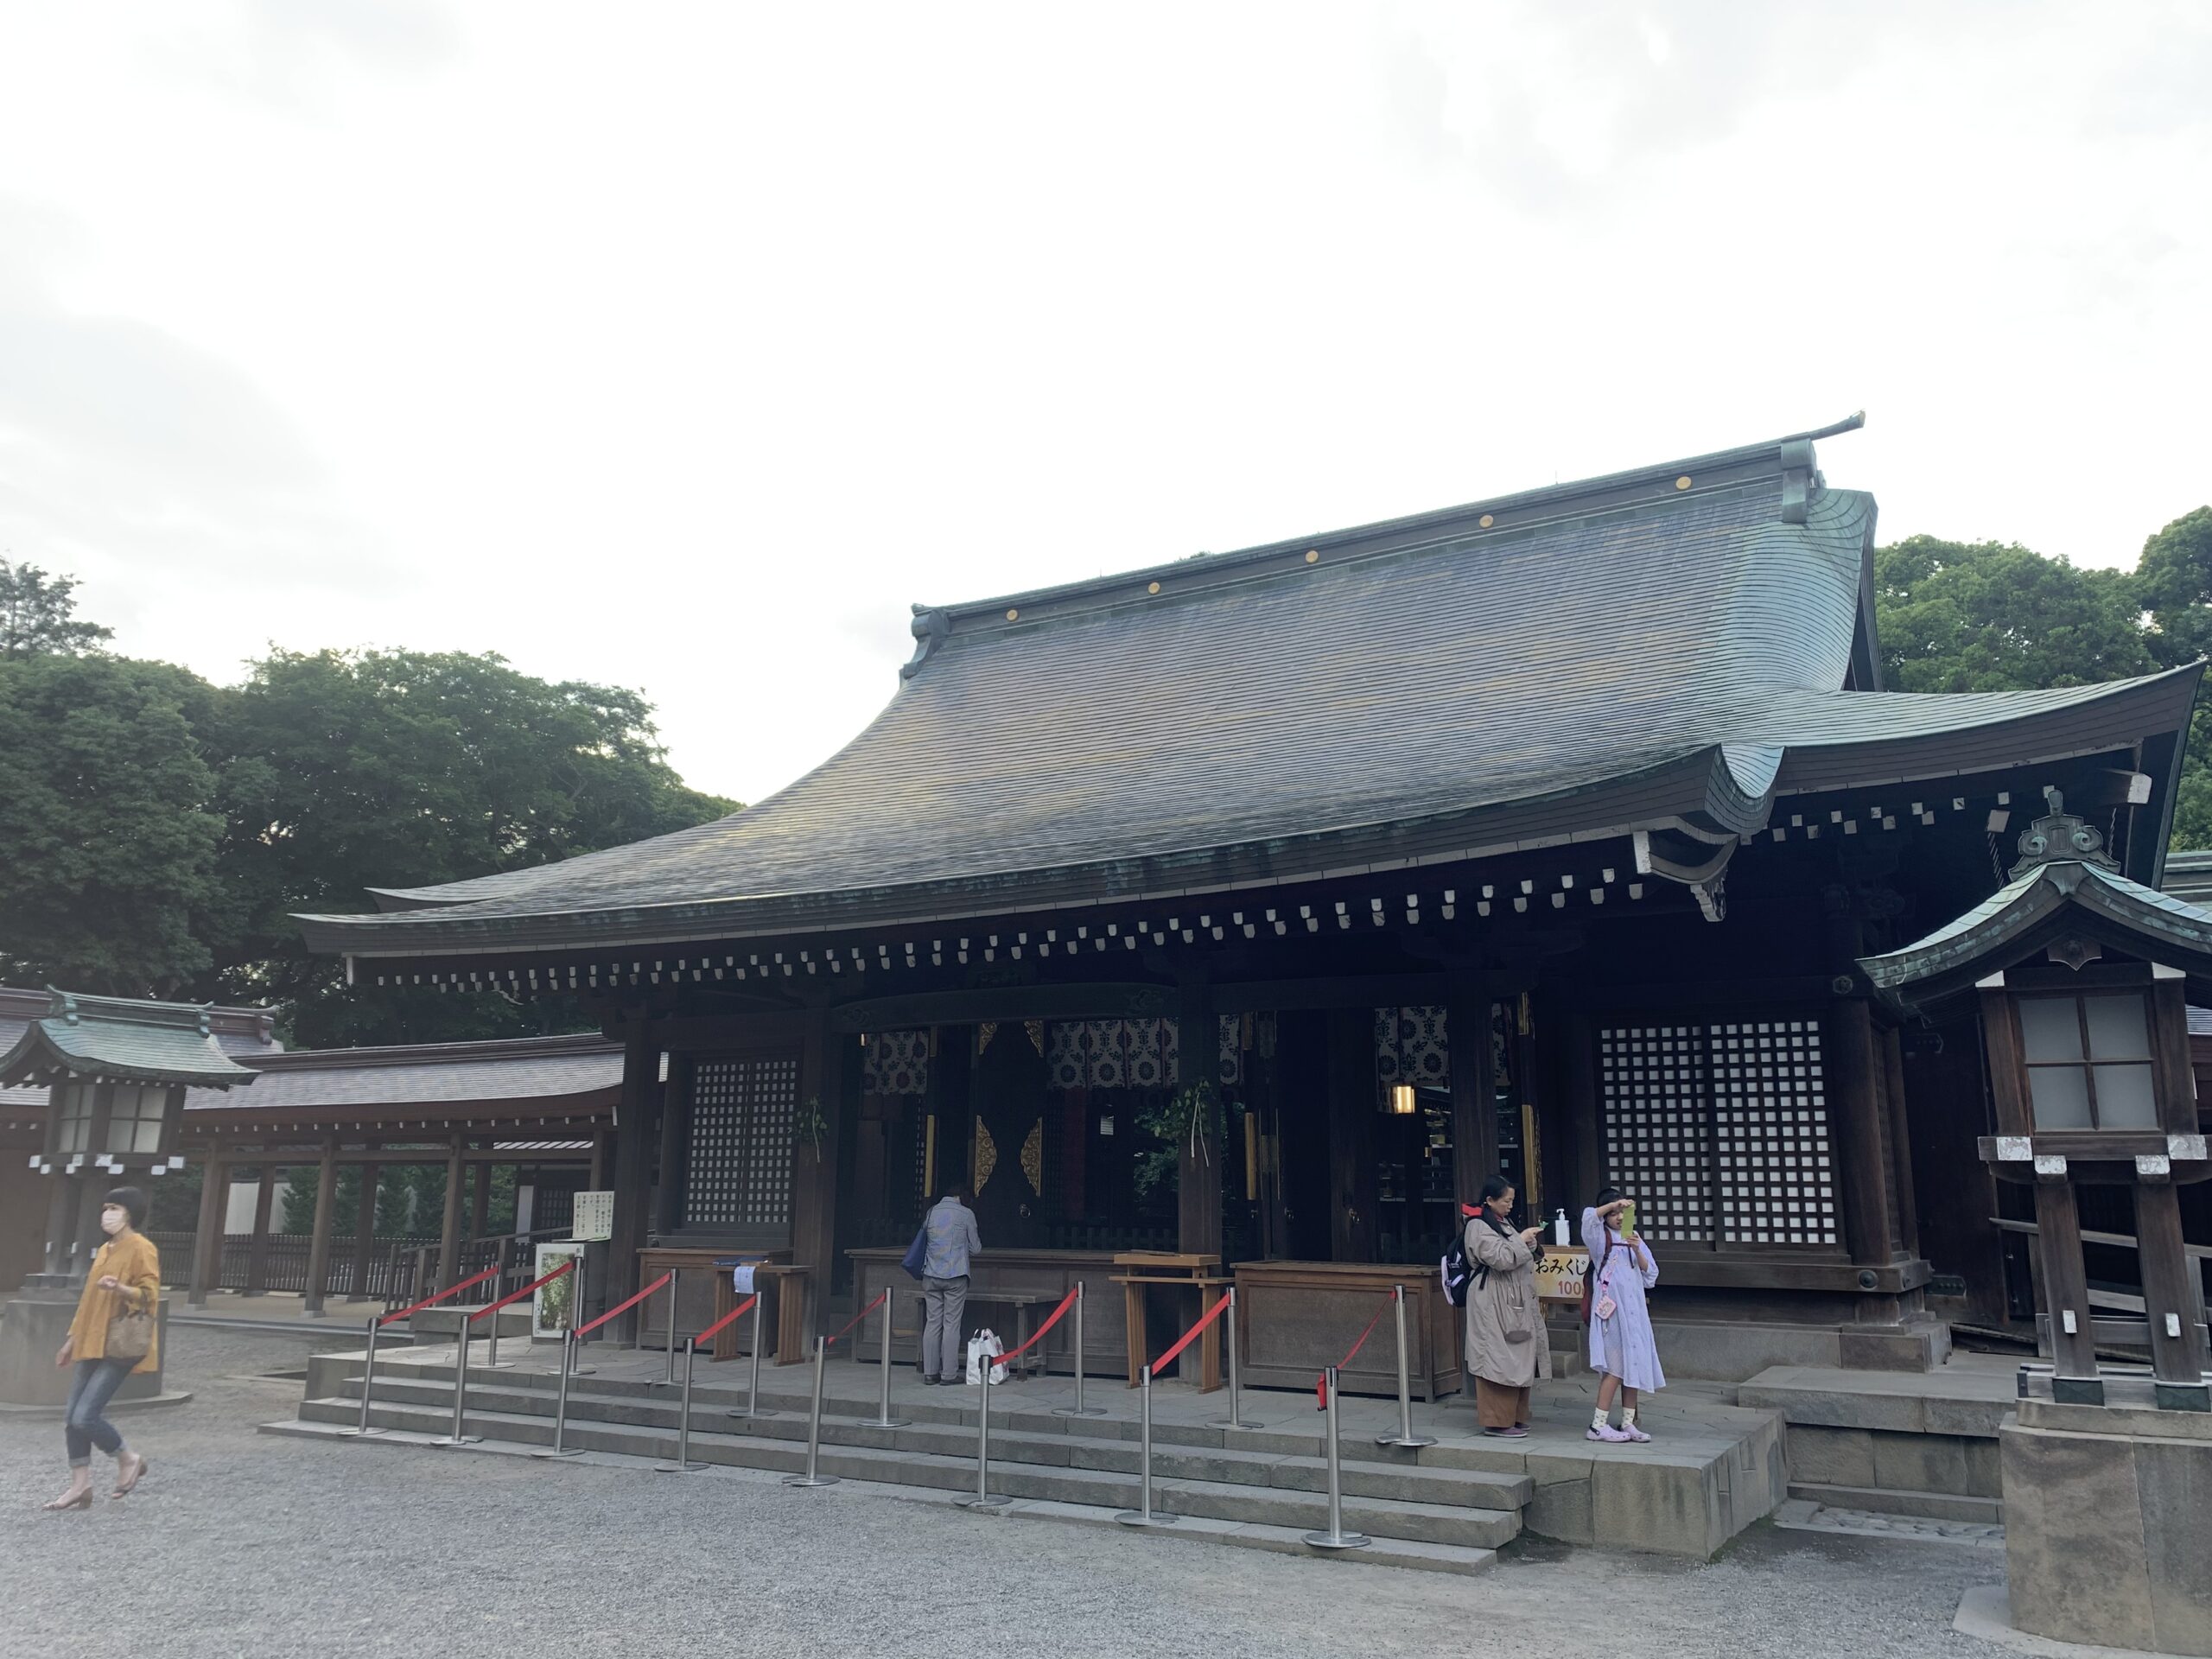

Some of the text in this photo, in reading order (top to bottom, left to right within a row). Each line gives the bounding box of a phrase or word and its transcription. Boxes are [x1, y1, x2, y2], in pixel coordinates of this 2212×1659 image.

[1535, 1258, 1586, 1275] おみくじ
[1558, 1281, 1584, 1295] 100
